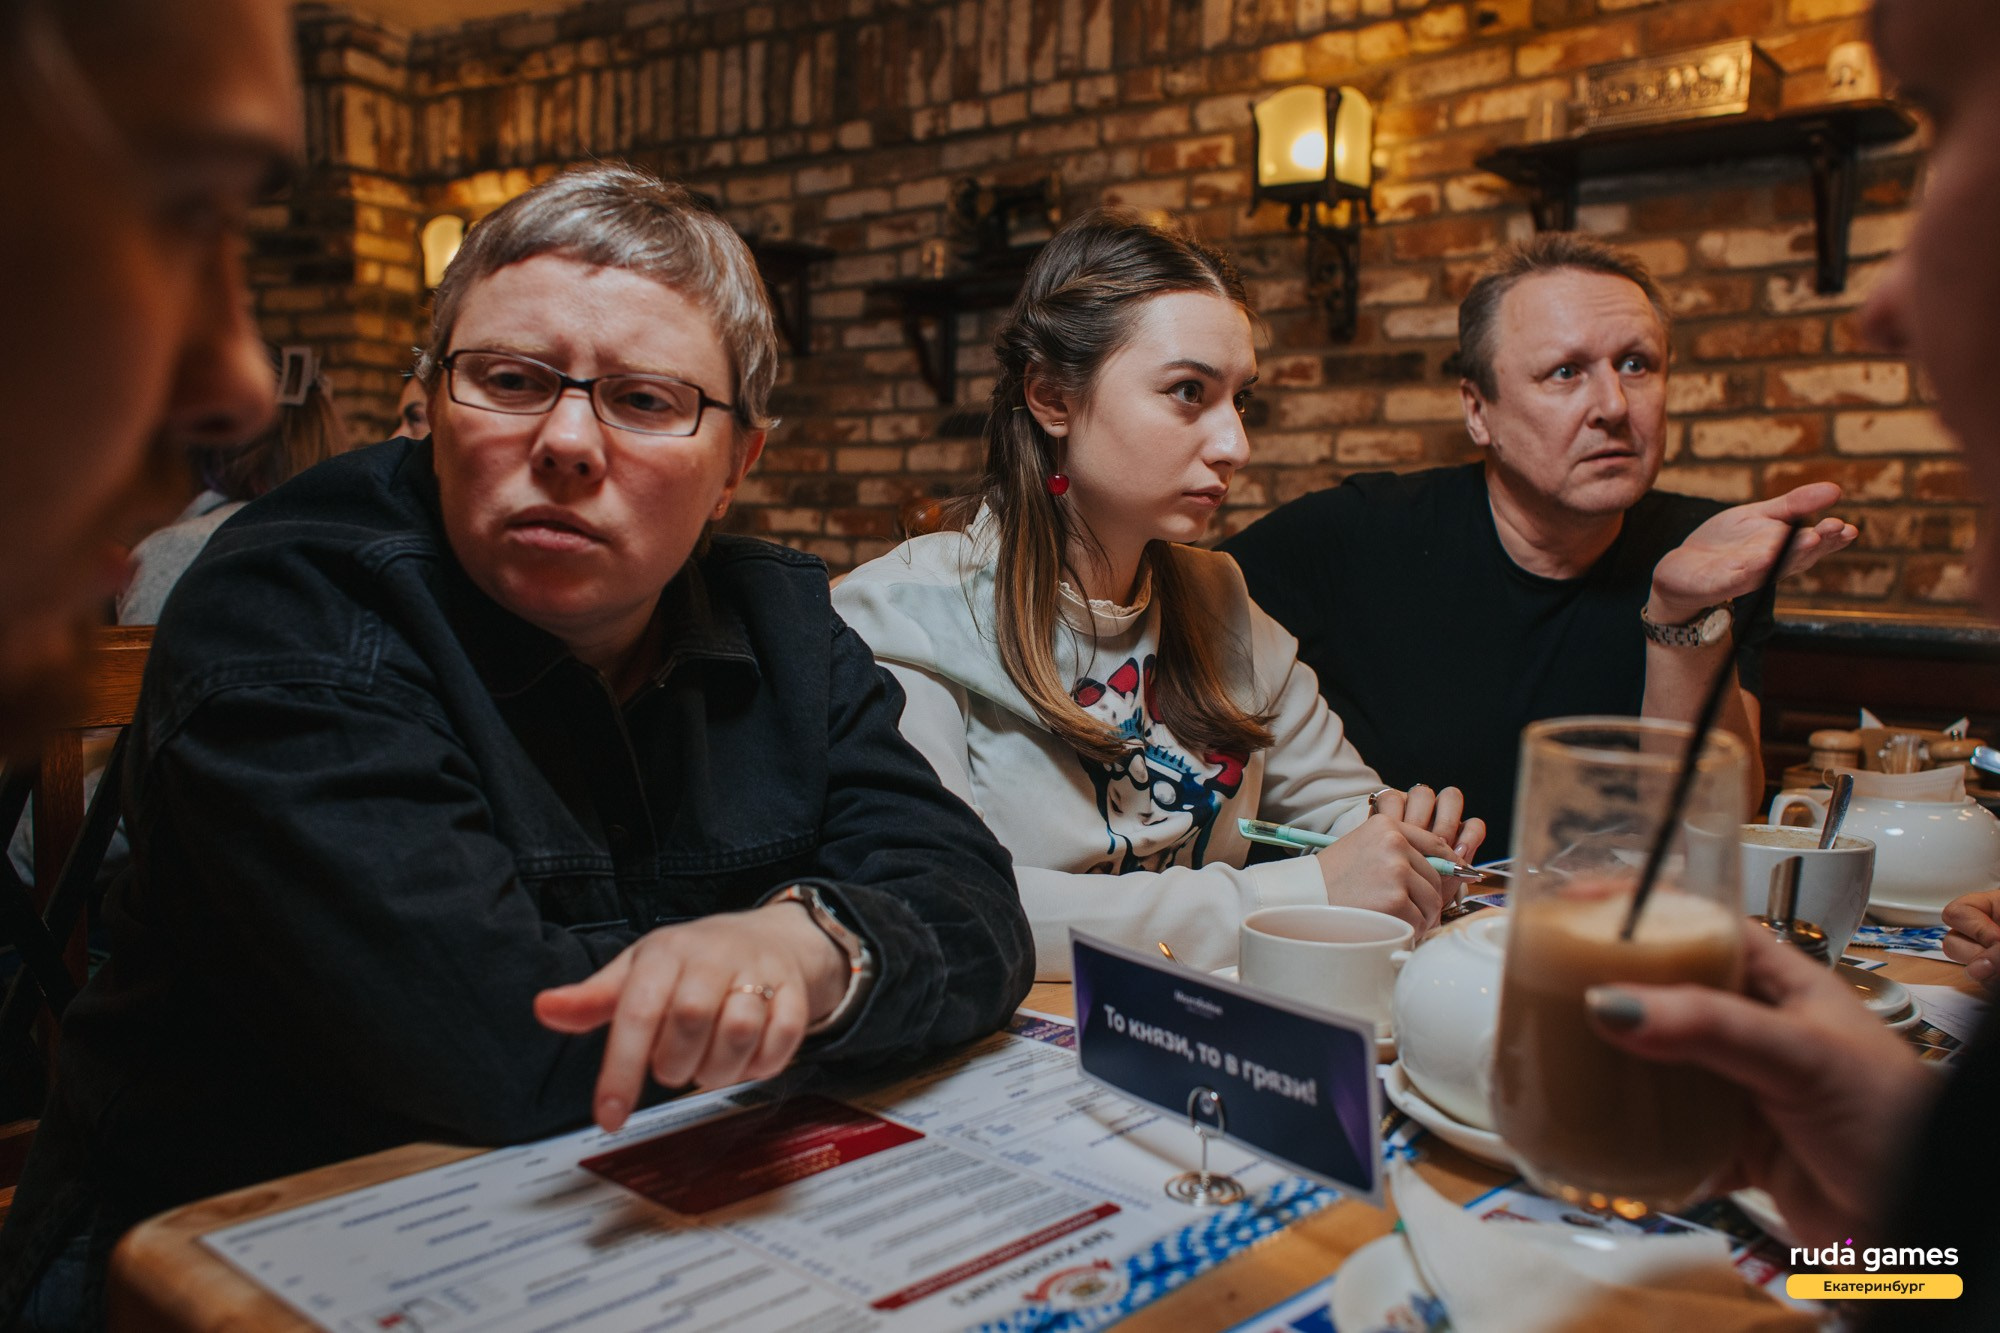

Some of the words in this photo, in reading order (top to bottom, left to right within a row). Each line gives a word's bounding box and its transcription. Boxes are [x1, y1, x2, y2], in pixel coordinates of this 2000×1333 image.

[1103, 1004, 1126, 1033] То
[1128, 1017, 1194, 1063] князи,
[1197, 1042, 1222, 1068] то
[1224, 1052, 1238, 1076] в
[1243, 1060, 1318, 1105] грязи!
